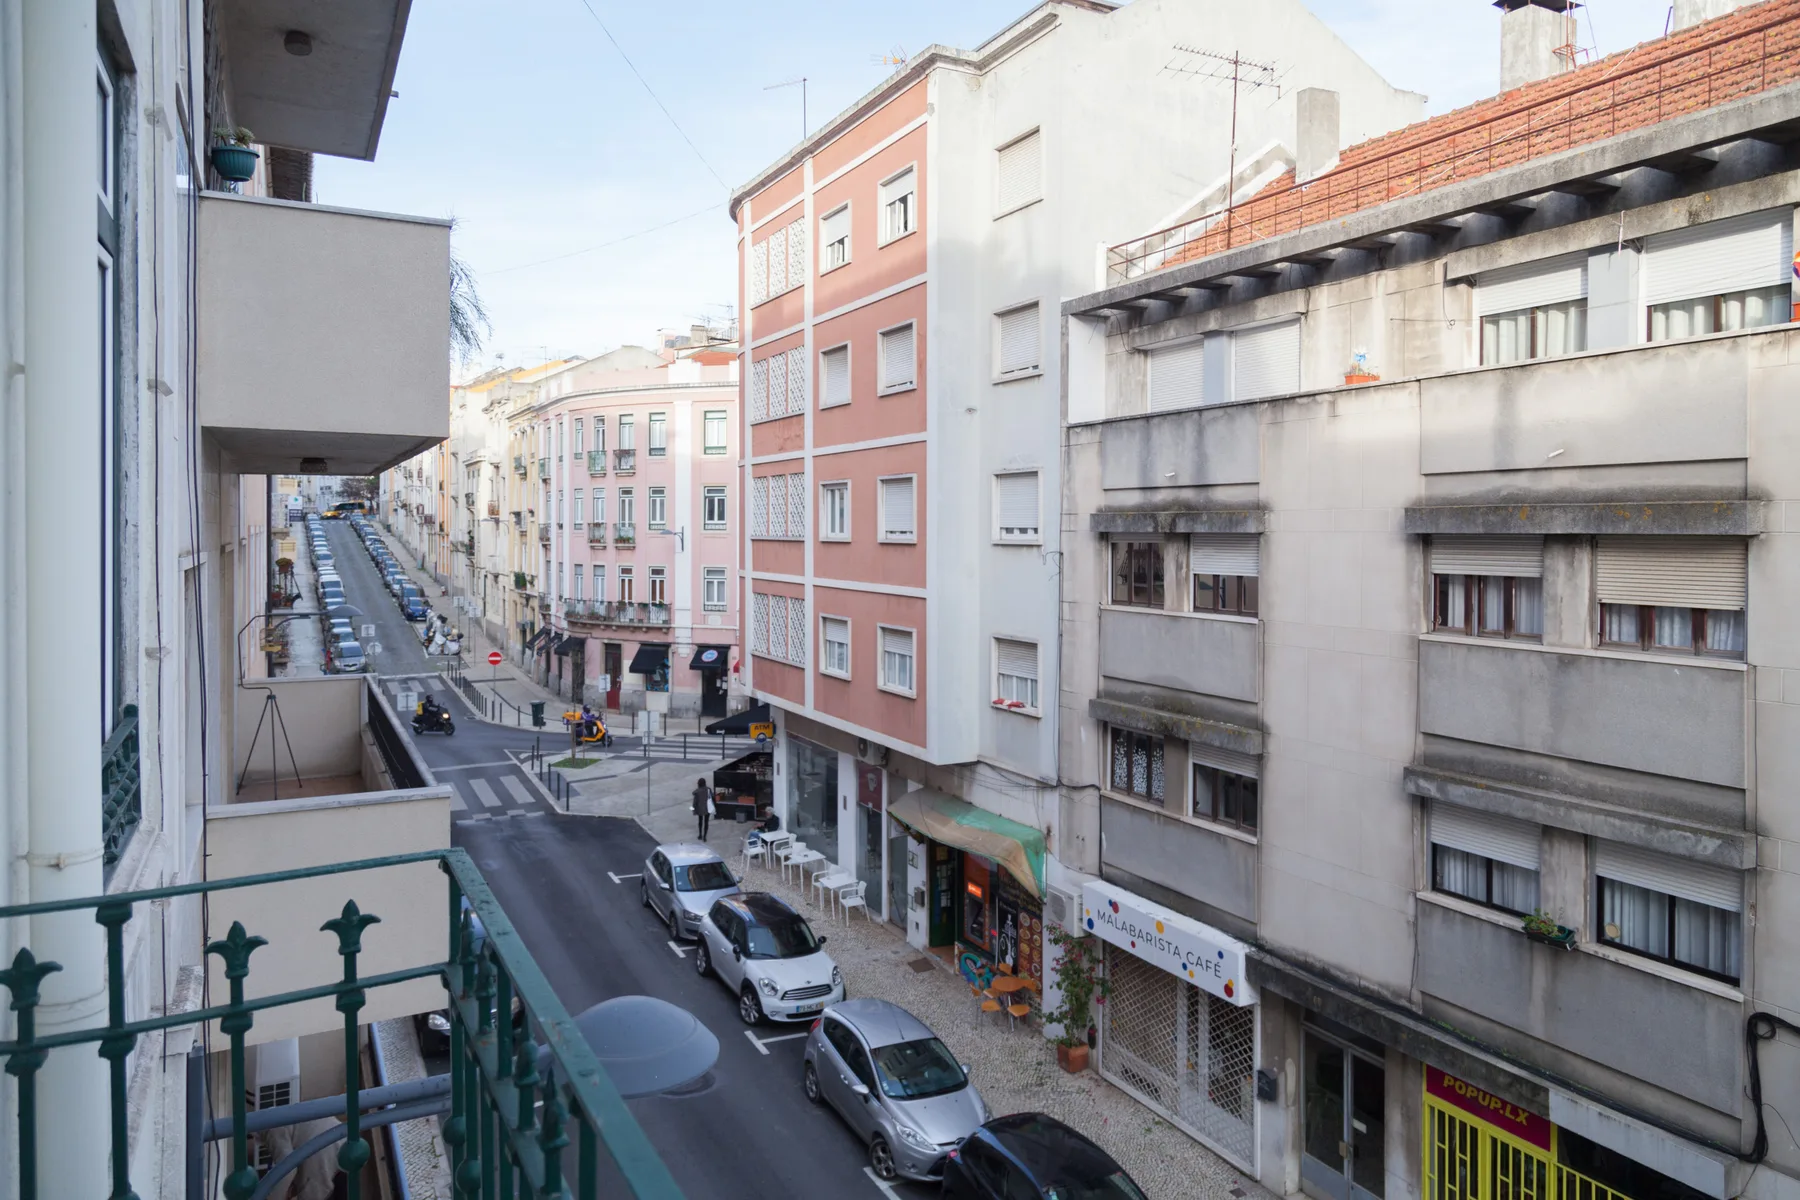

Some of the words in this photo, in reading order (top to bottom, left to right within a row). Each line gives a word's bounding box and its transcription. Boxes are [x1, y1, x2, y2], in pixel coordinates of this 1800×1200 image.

[754, 723, 770, 731] ATM
[1097, 909, 1182, 960] MALABARISTA
[1186, 951, 1222, 979] CAFÉ
[1444, 1075, 1530, 1125] POPUP.LX
